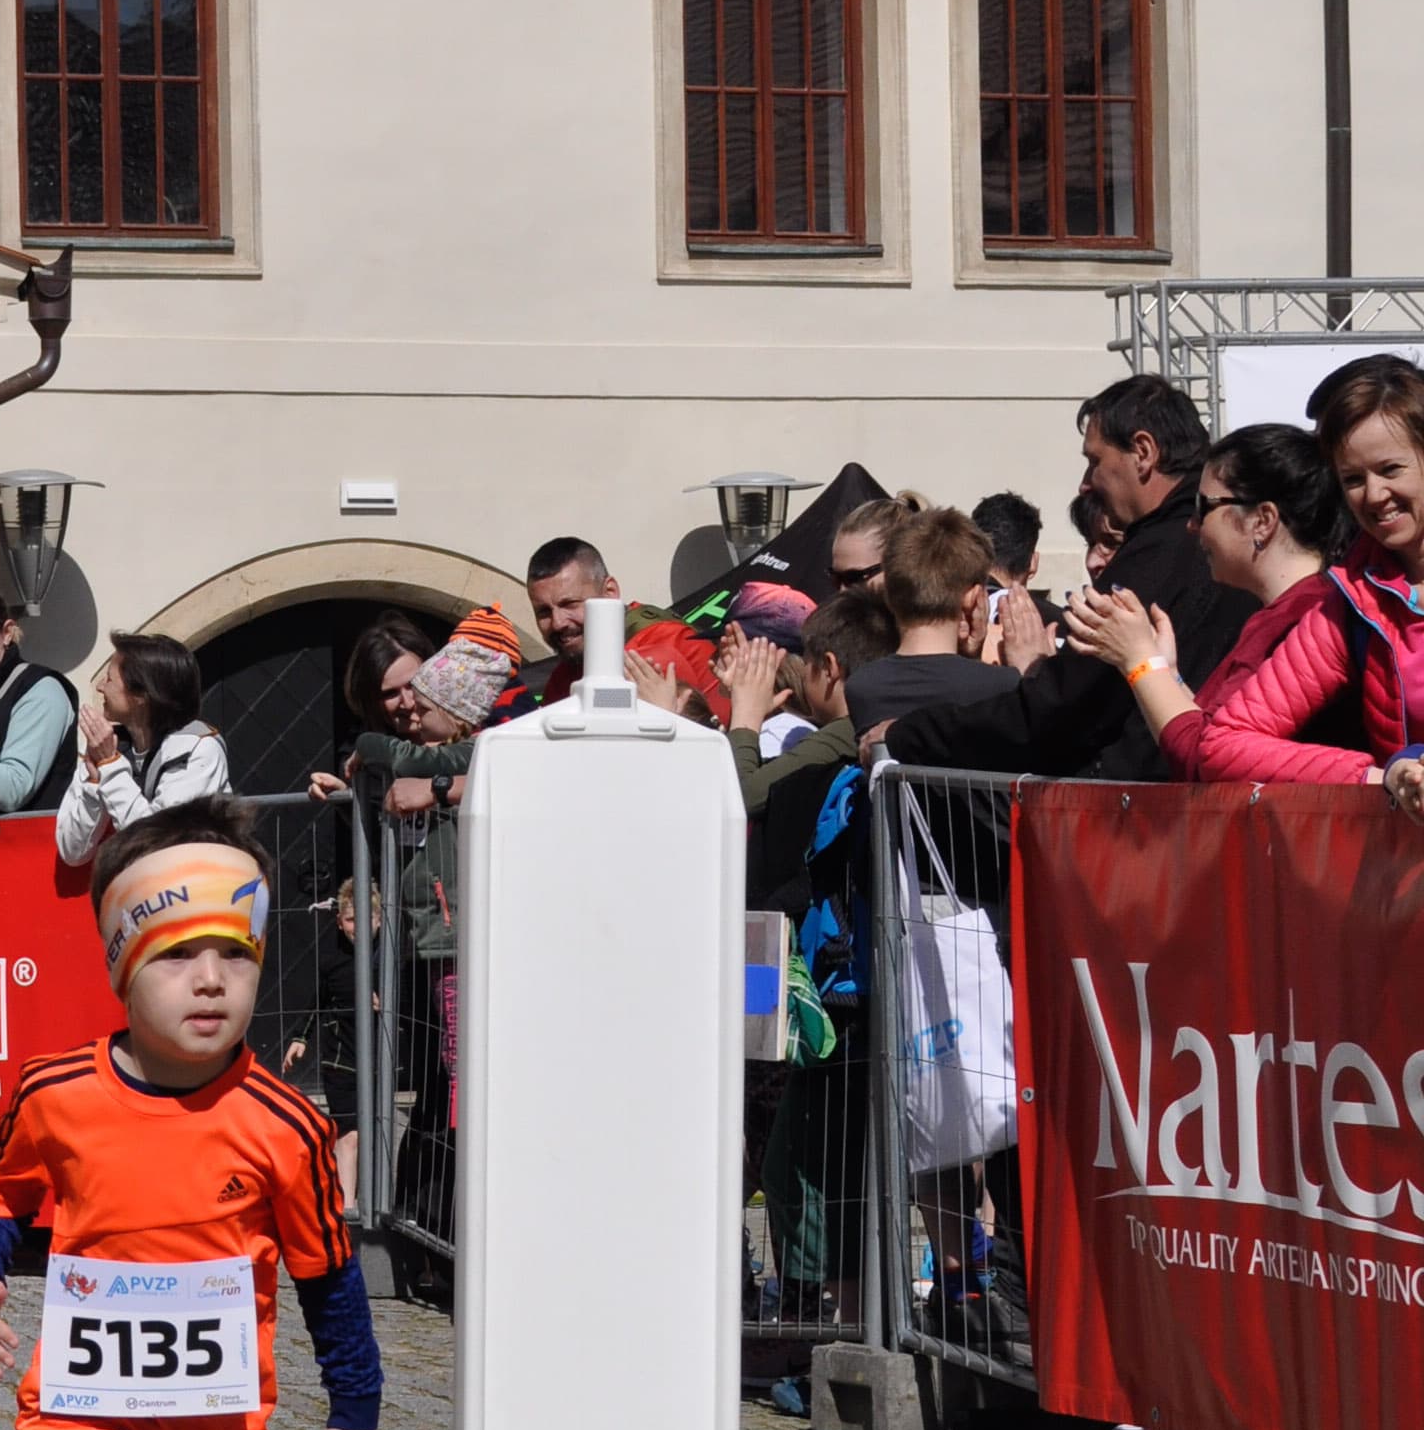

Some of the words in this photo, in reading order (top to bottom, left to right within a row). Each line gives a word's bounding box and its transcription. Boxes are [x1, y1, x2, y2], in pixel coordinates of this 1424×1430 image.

[131, 886, 189, 926] RUN
[1149, 1224, 1239, 1273] QUALITY
[130, 1275, 178, 1291] PVZP
[221, 1285, 242, 1297] run
[68, 1316, 223, 1379] 5135
[66, 1393, 99, 1406] PVZP
